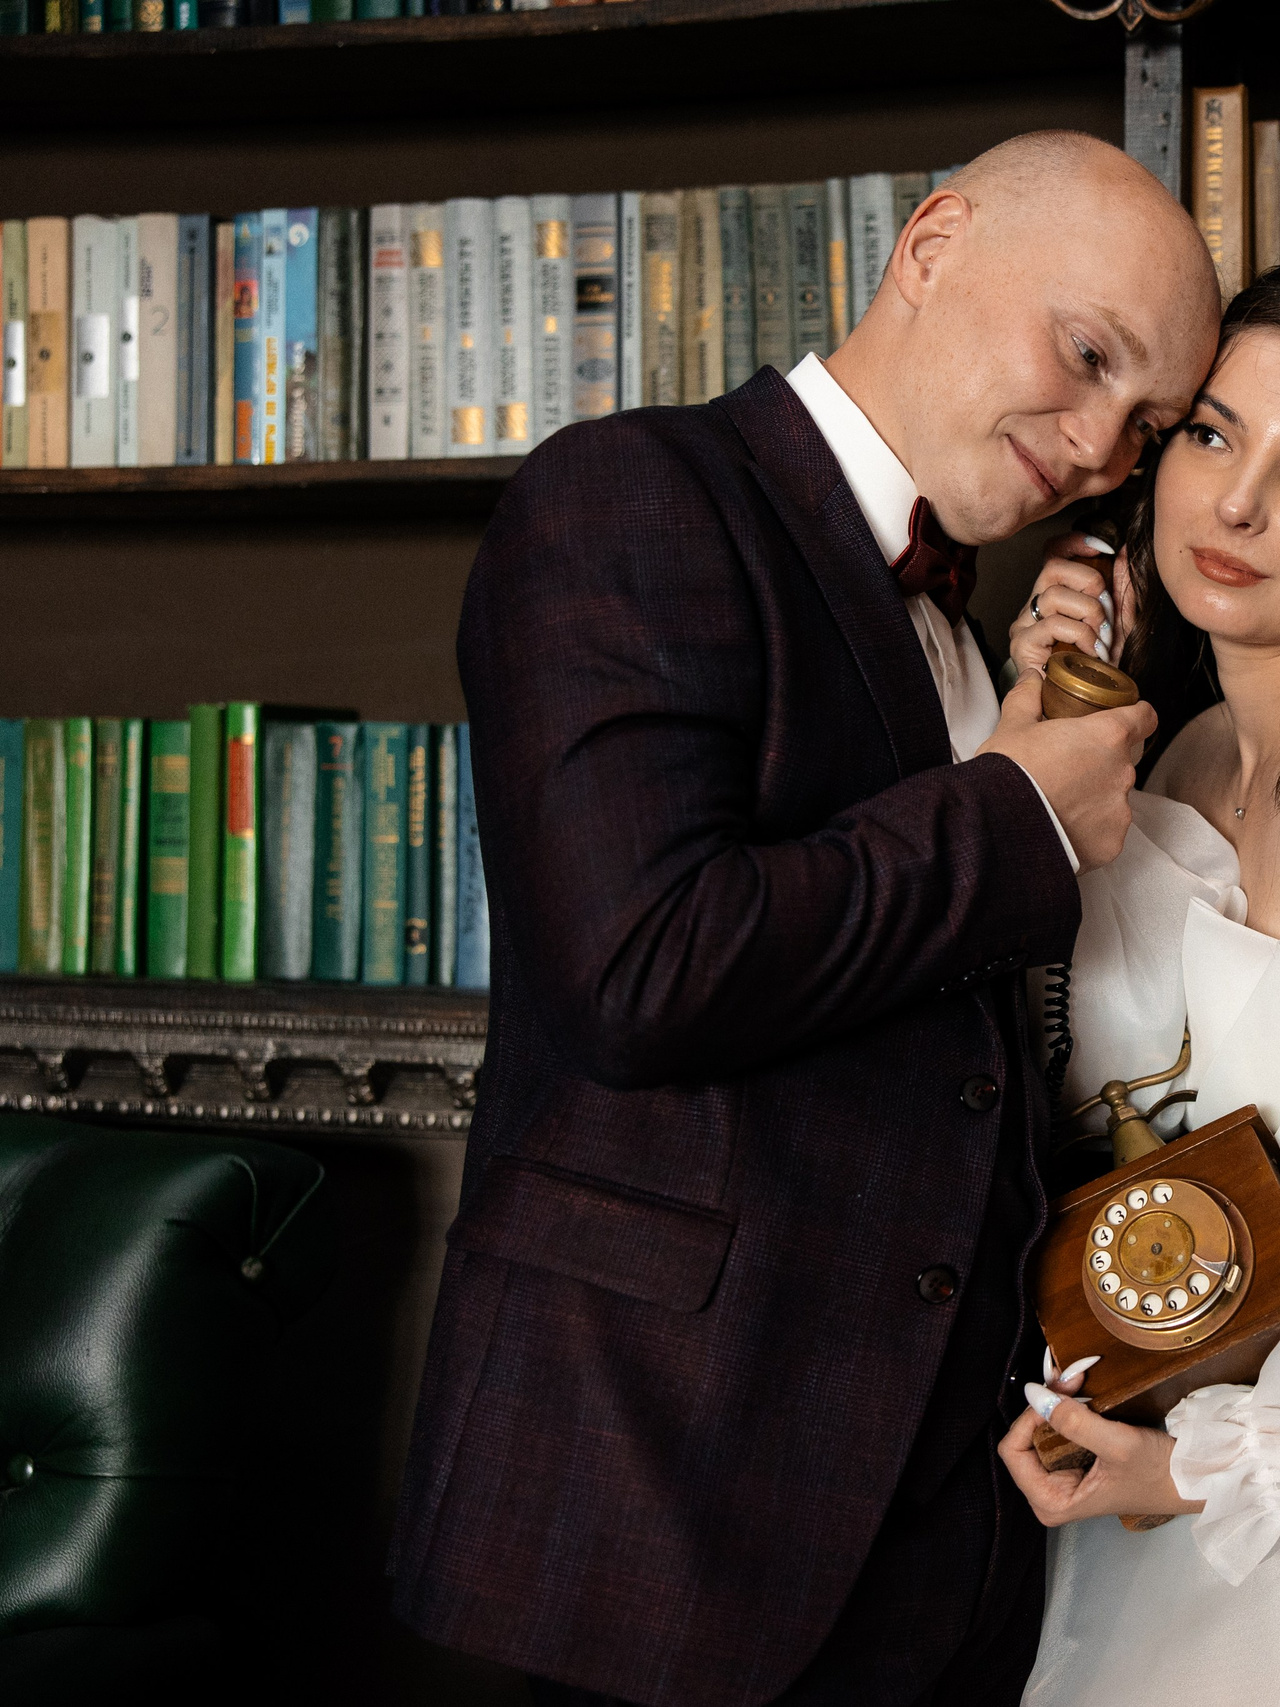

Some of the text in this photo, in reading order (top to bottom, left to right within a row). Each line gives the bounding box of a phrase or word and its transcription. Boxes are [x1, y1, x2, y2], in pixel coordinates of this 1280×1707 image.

[1115, 1210, 1125, 1223] 3
[1100, 1229, 1109, 1241] 4
[1095, 1255, 1105, 1269] 5
[1101, 1279, 1111, 1292] 6
[1120, 1296, 1129, 1309] 7
[1168, 1300, 1177, 1311] 9
[1142, 1303, 1153, 1316] 8
